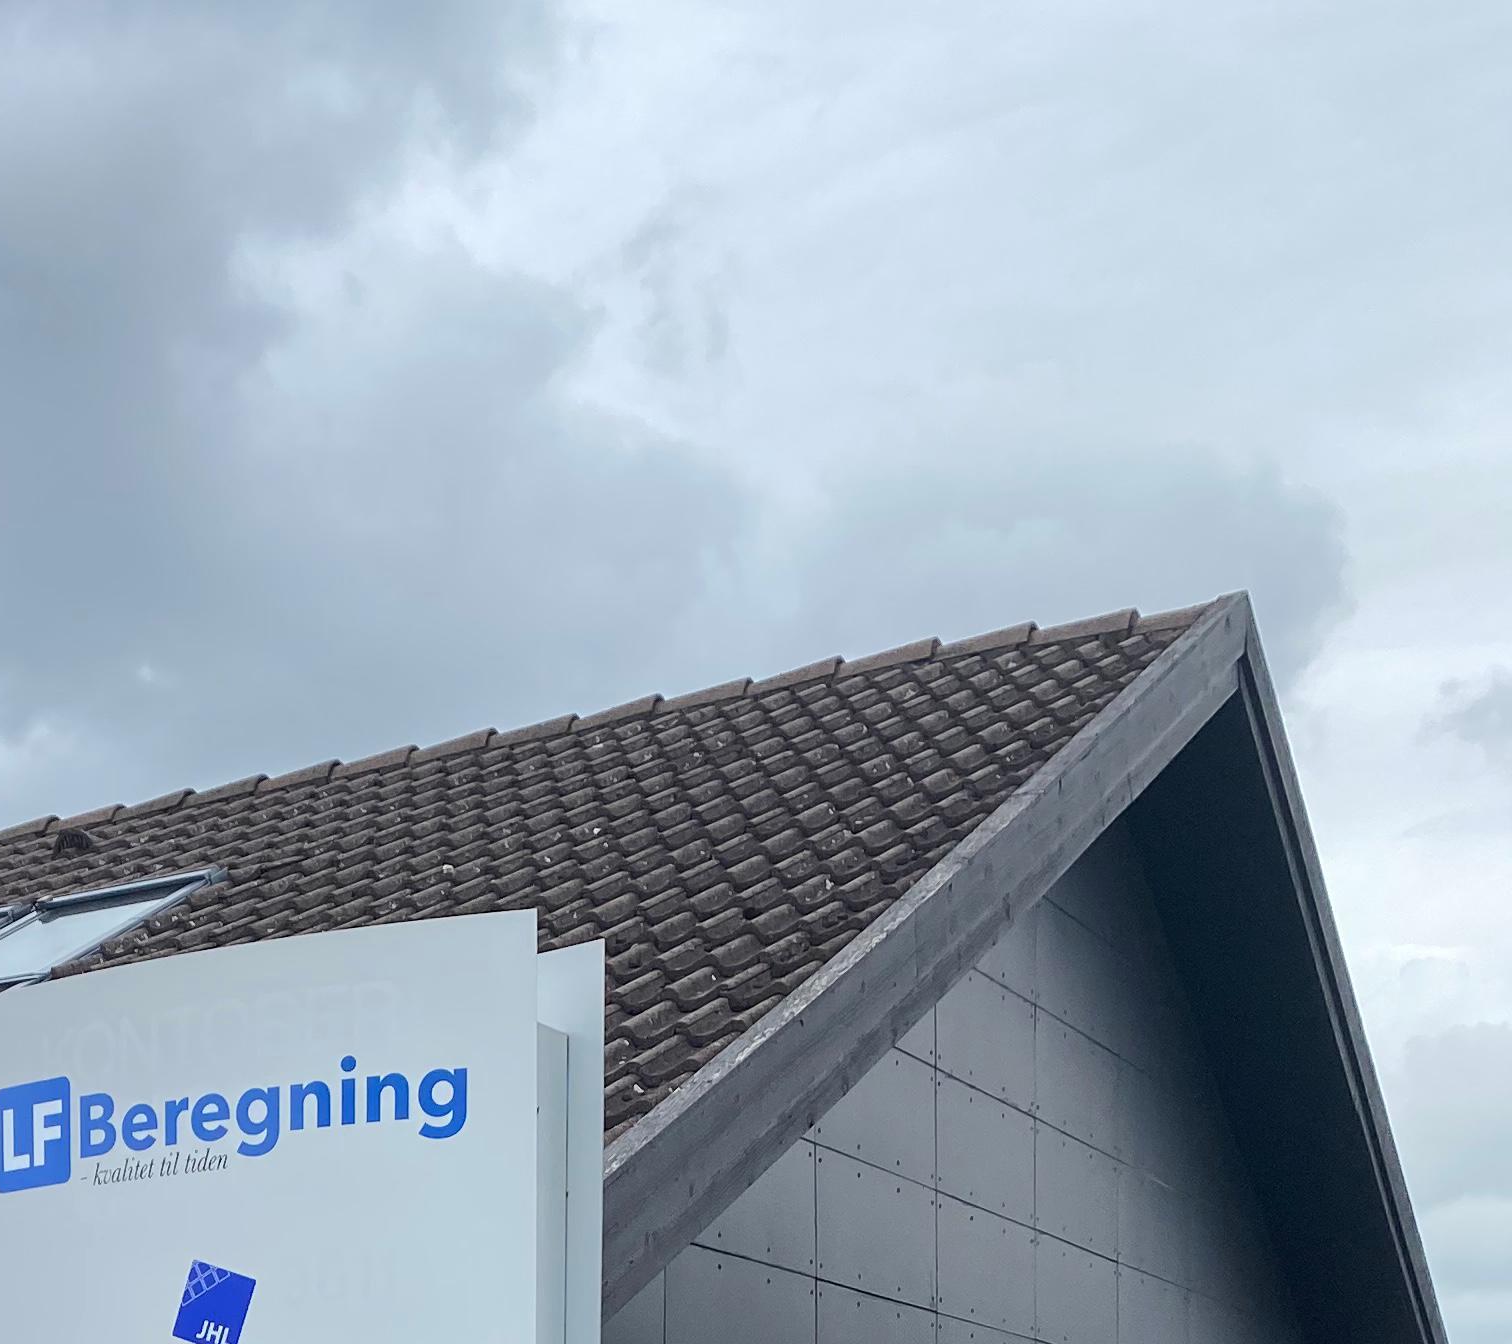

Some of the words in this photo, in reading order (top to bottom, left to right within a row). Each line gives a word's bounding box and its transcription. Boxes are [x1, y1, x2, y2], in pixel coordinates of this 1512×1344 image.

[1, 1099, 64, 1173] LF
[79, 1055, 469, 1159] Beregning
[92, 1156, 154, 1187] kvalitet
[159, 1151, 180, 1178] til
[184, 1147, 228, 1175] tiden
